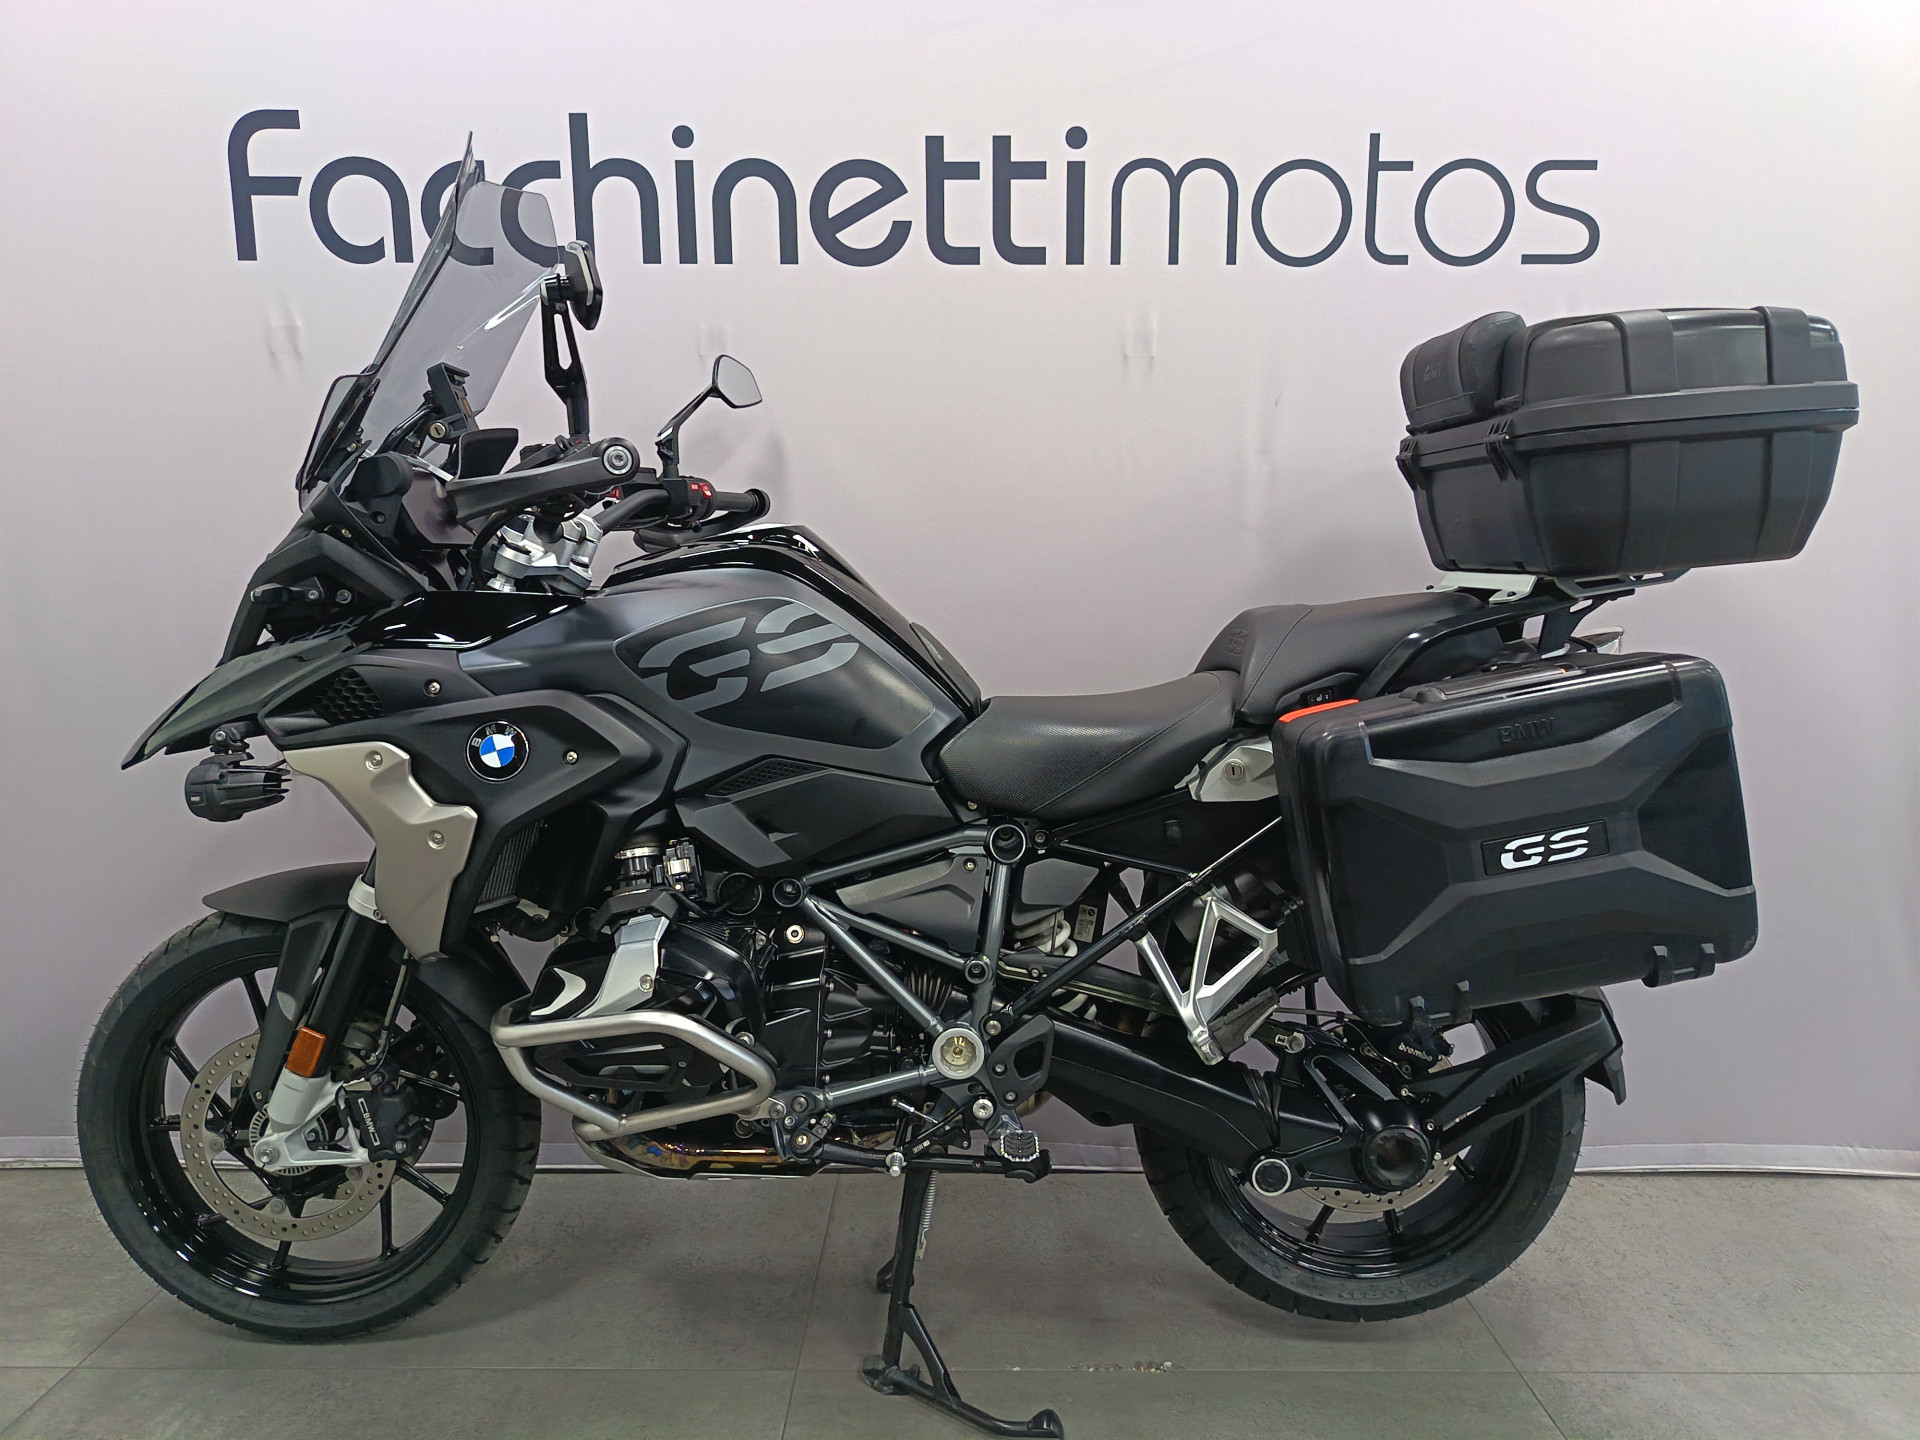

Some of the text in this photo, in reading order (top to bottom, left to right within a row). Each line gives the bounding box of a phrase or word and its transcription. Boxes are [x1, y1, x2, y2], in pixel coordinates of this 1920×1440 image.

[637, 602, 859, 714] GS
[471, 724, 518, 748] BMW
[1497, 716, 1556, 744] BMW
[1500, 825, 1590, 870] GS
[1398, 1041, 1433, 1062] brembo
[362, 1112, 376, 1133] BMW
